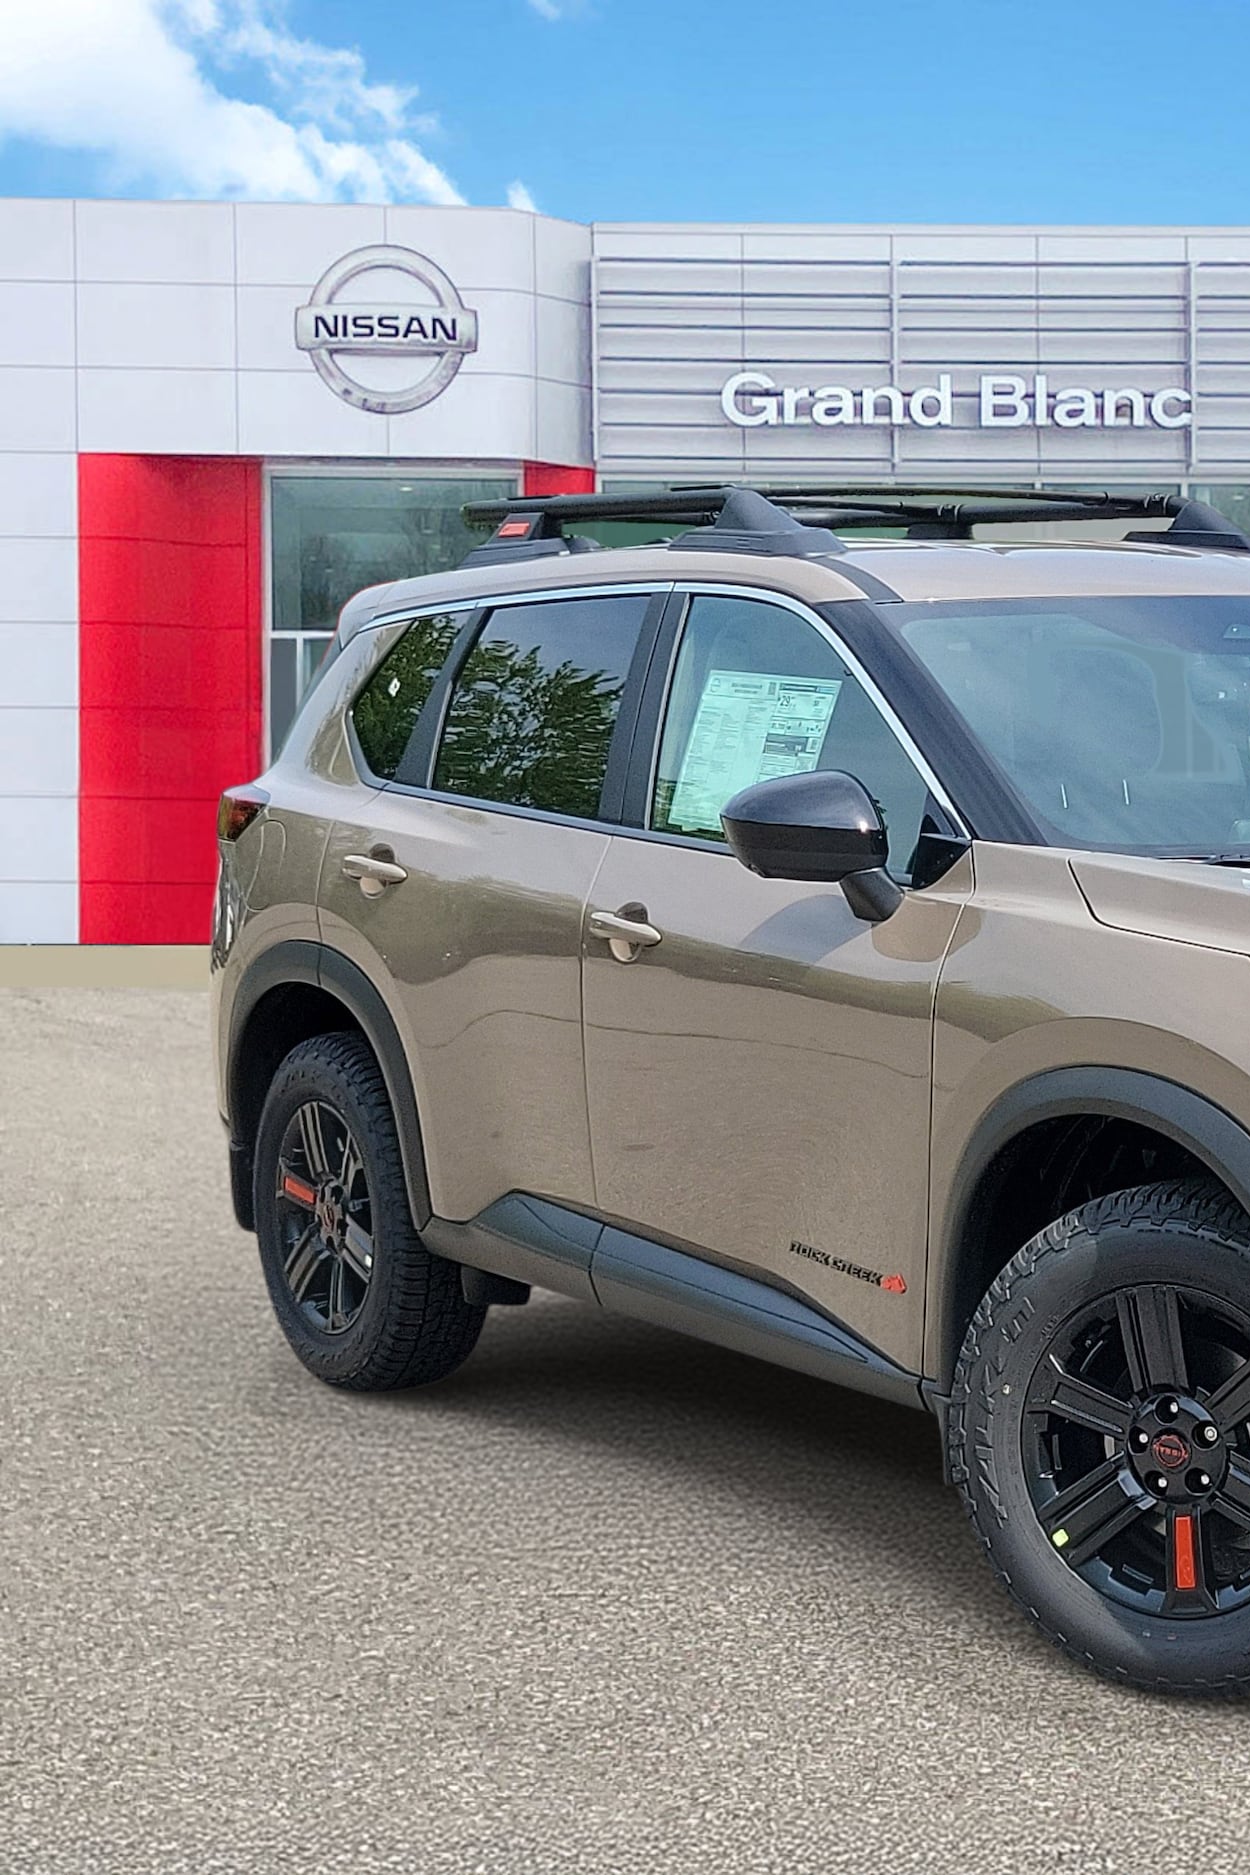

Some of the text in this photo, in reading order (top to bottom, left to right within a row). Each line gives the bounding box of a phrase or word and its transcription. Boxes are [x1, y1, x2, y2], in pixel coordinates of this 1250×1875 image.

[313, 314, 458, 341] NISSAN
[720, 371, 1194, 429] Grand Blanc
